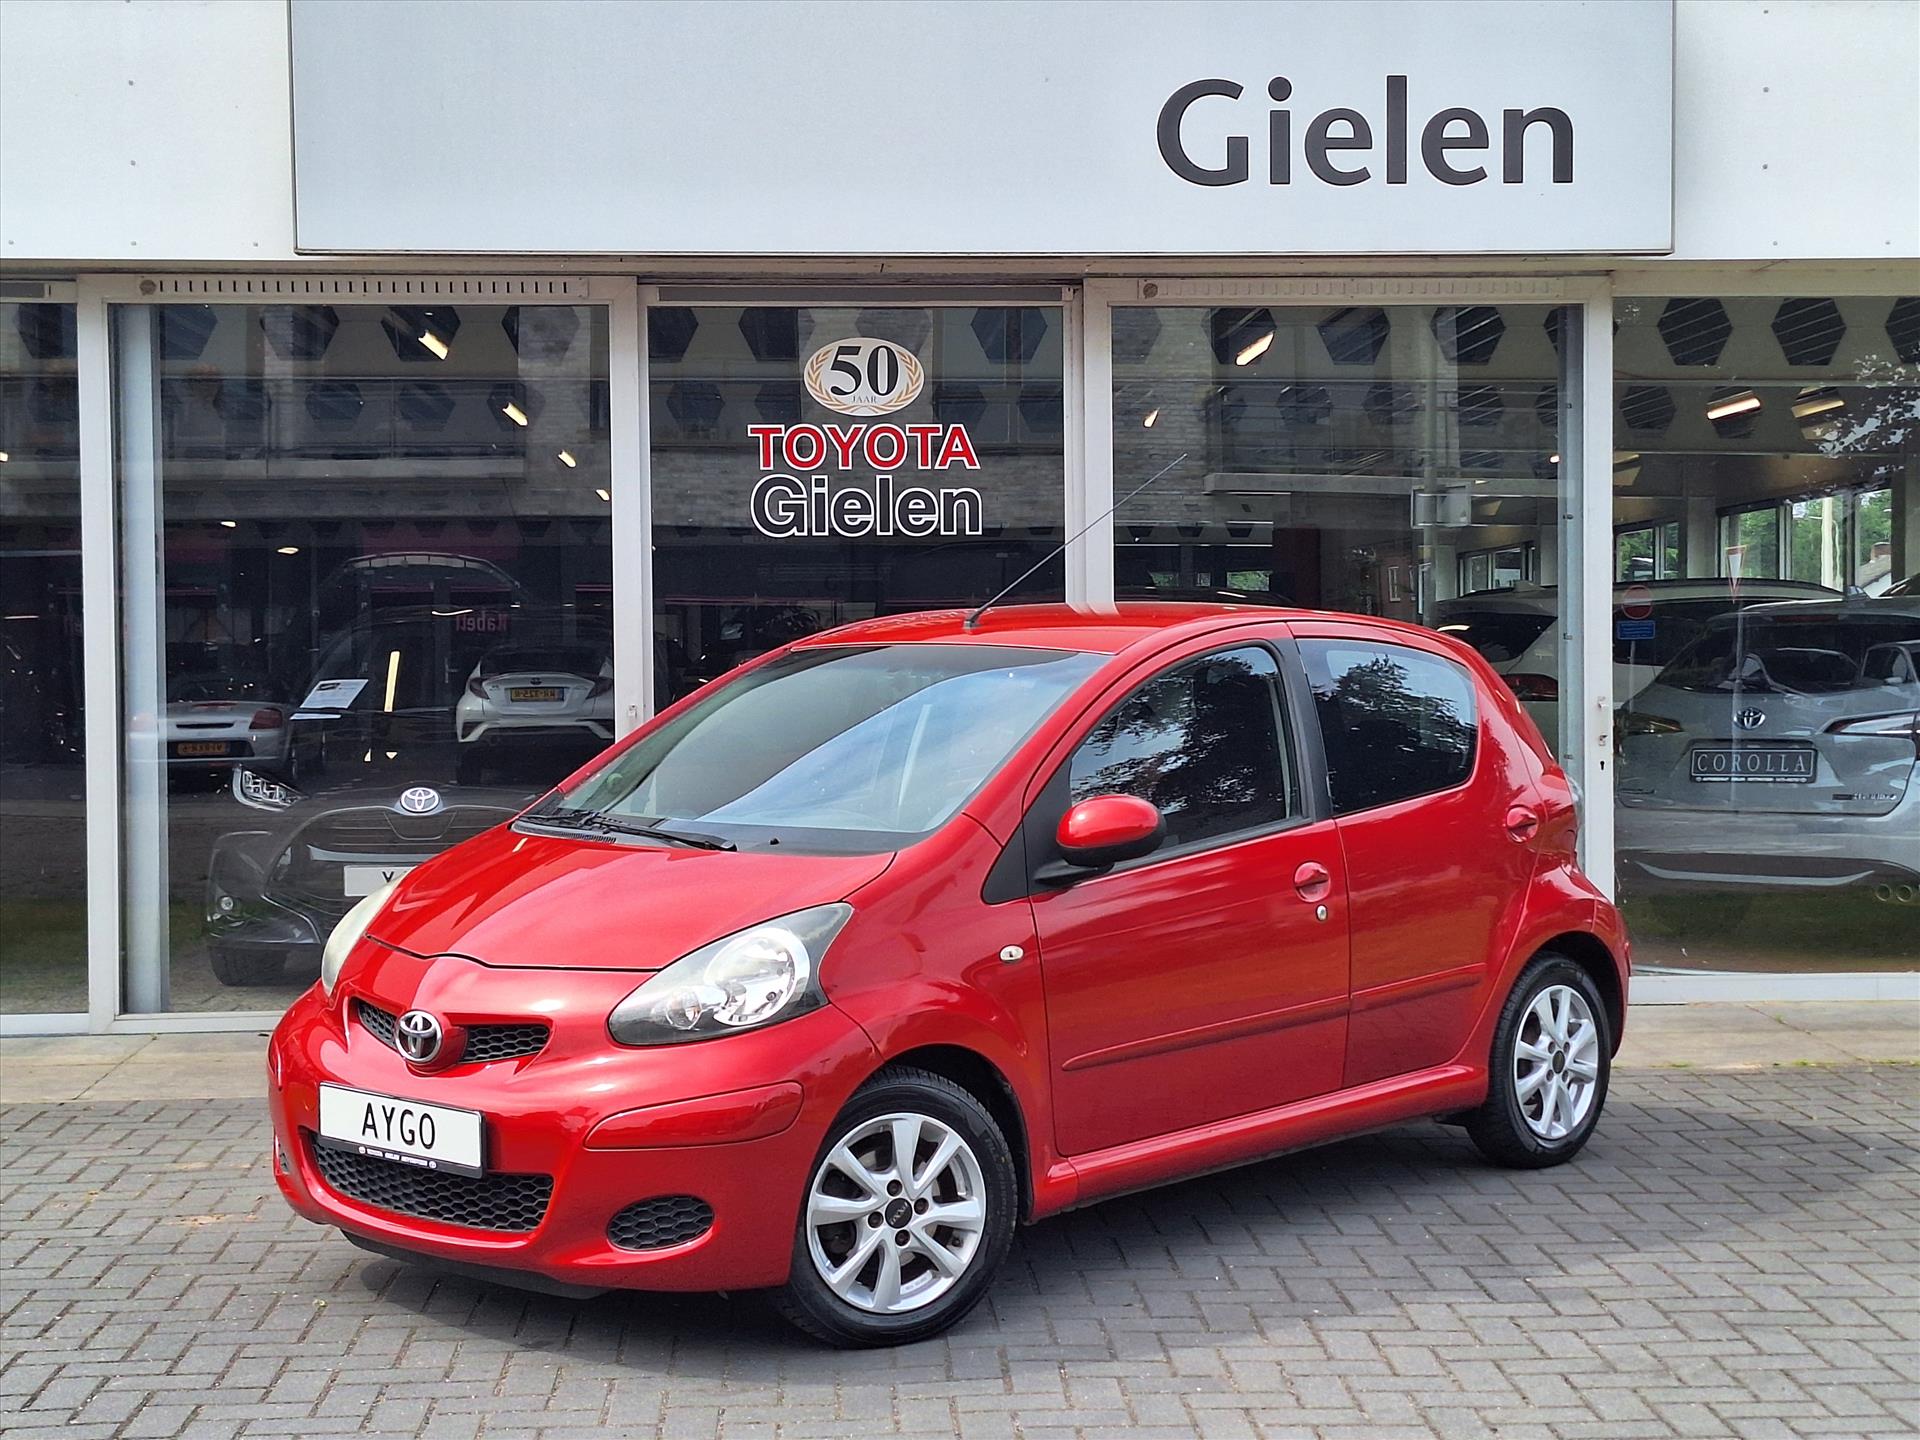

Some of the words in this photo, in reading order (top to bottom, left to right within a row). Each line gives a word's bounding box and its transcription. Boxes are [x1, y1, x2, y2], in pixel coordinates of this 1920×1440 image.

[1157, 75, 1573, 186] Gielen
[830, 345, 899, 396] 50
[852, 395, 877, 404] JAAR
[747, 424, 981, 470] TOYOTA
[750, 474, 982, 537] Gielen
[1697, 754, 1806, 772] COROLLA
[361, 1102, 436, 1150] AYGO
